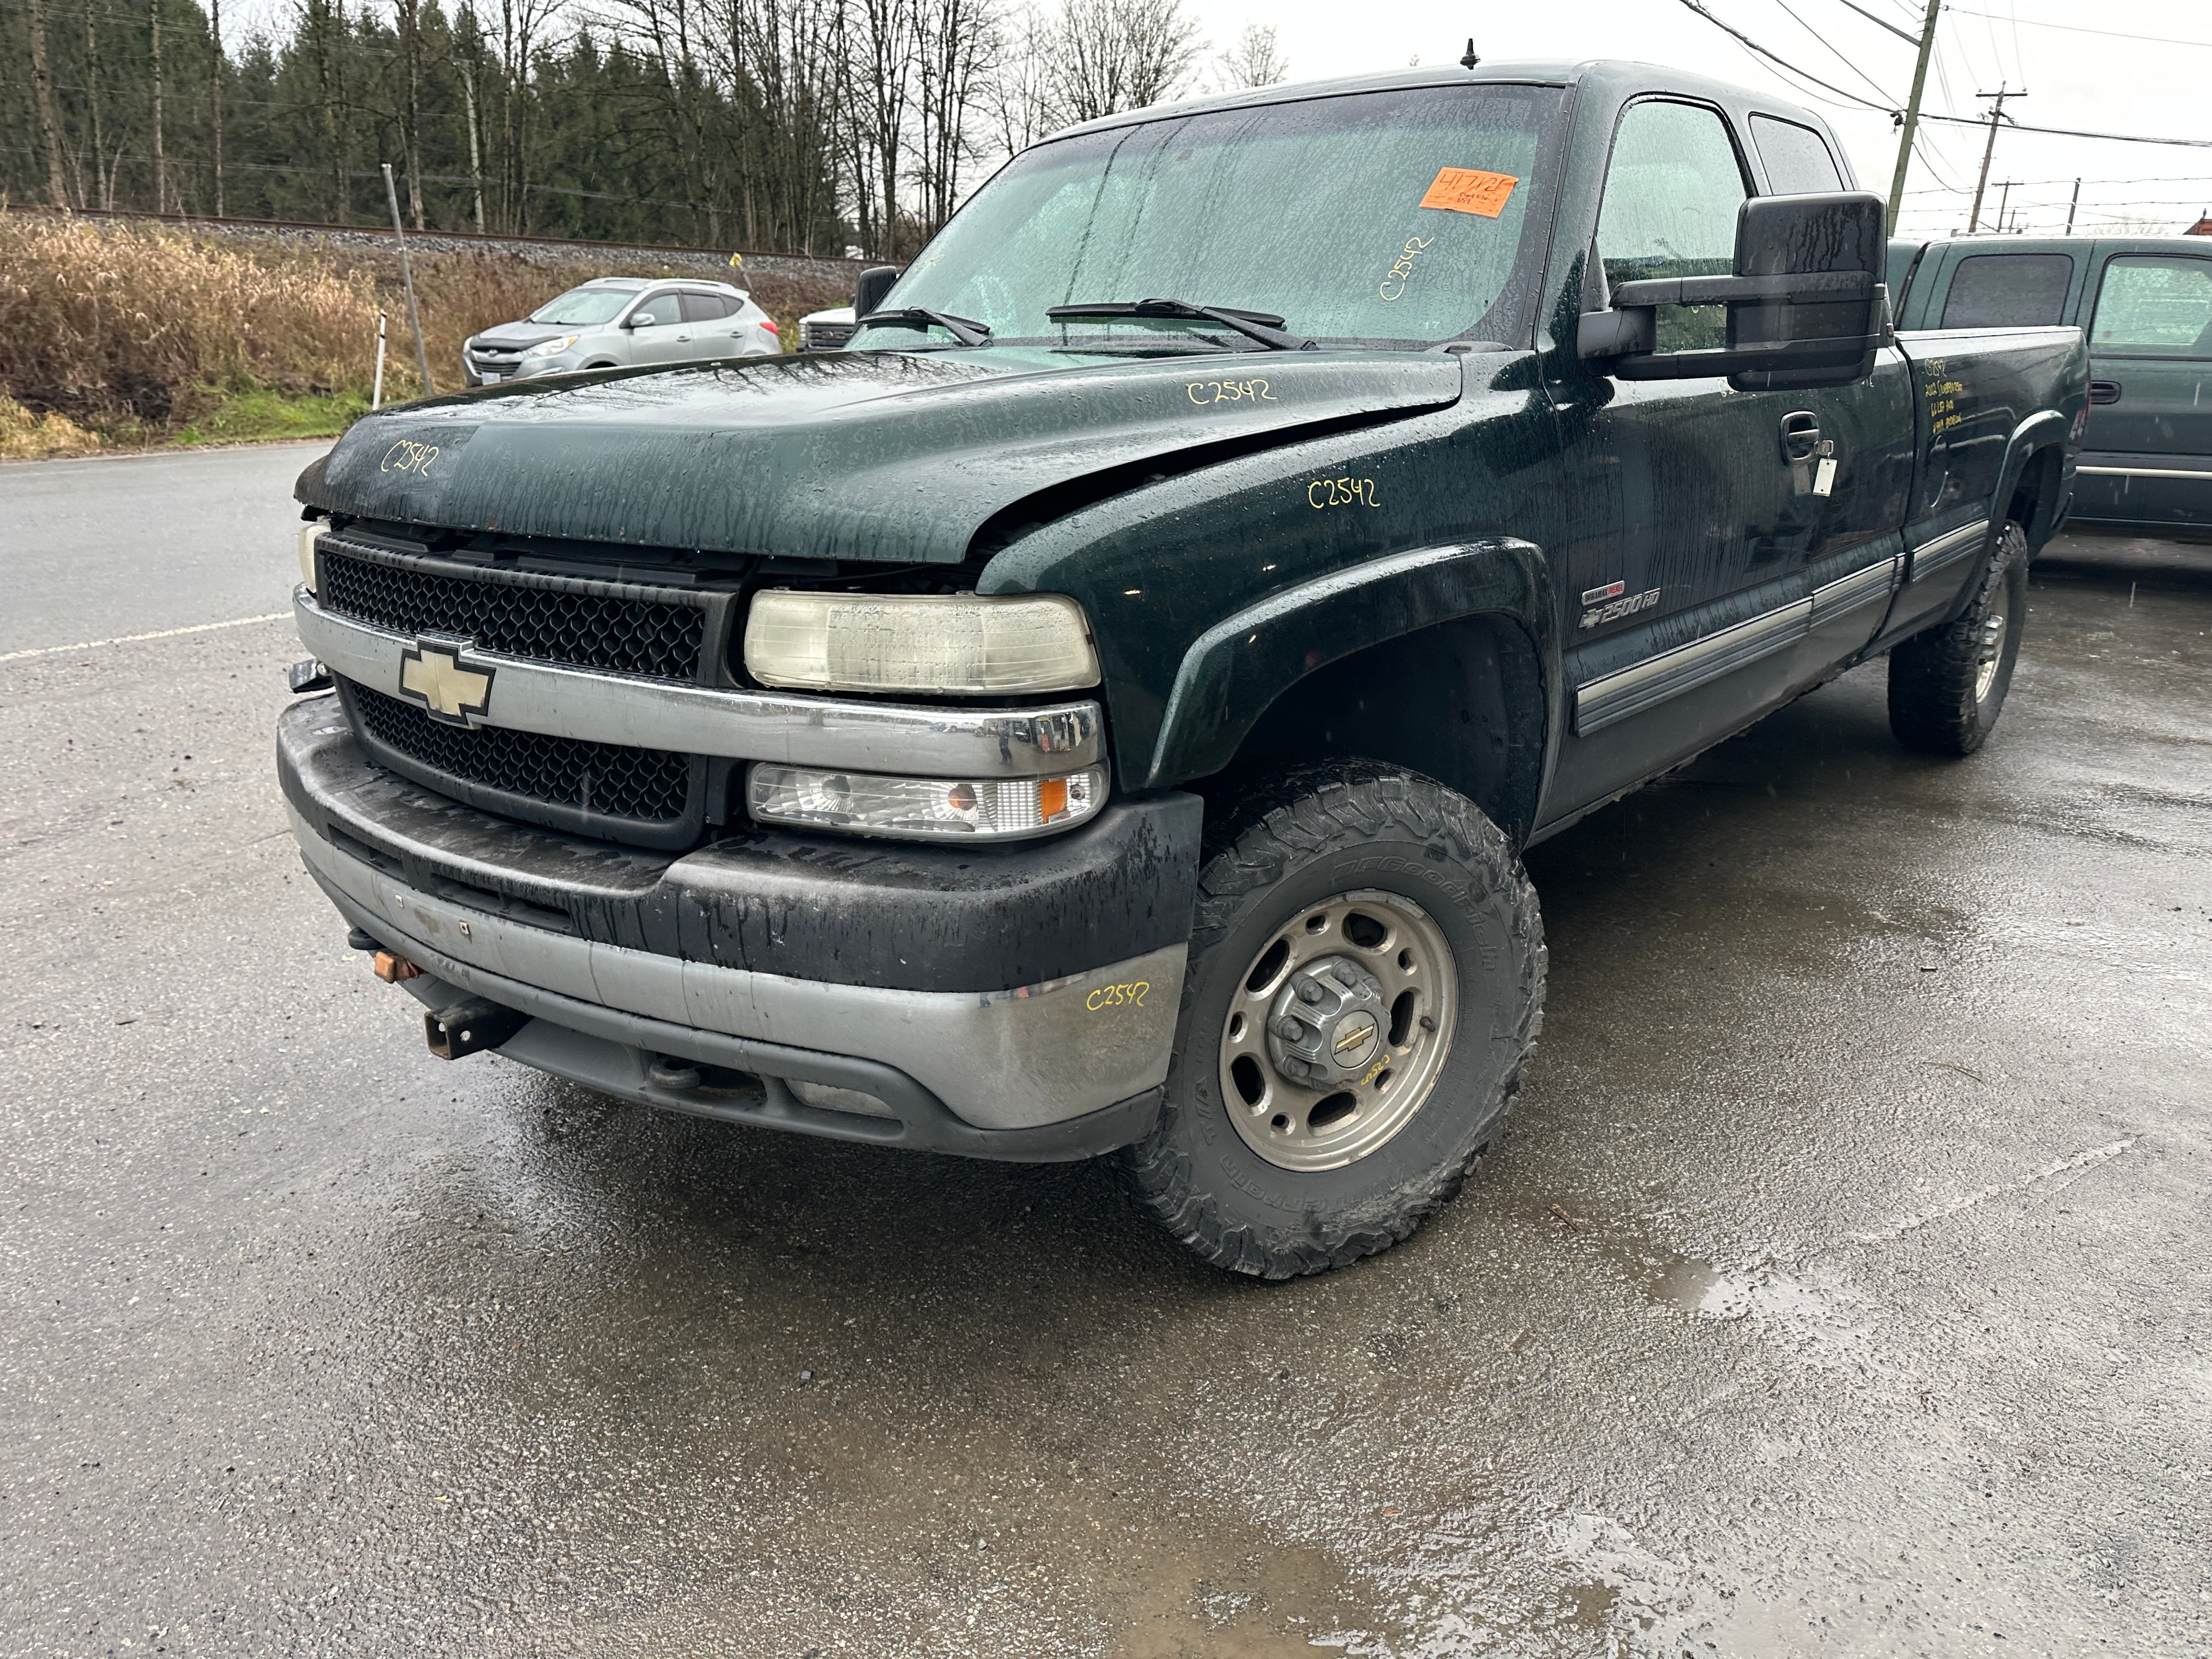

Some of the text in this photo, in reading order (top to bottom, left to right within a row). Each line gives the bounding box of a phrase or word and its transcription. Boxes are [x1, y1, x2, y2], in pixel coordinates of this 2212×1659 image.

[1380, 237, 1434, 301] C2542
[1188, 379, 1277, 404] C2542
[381, 440, 439, 477] C2542
[1308, 477, 1381, 509] C2542
[1086, 981, 1150, 1011] C2542
